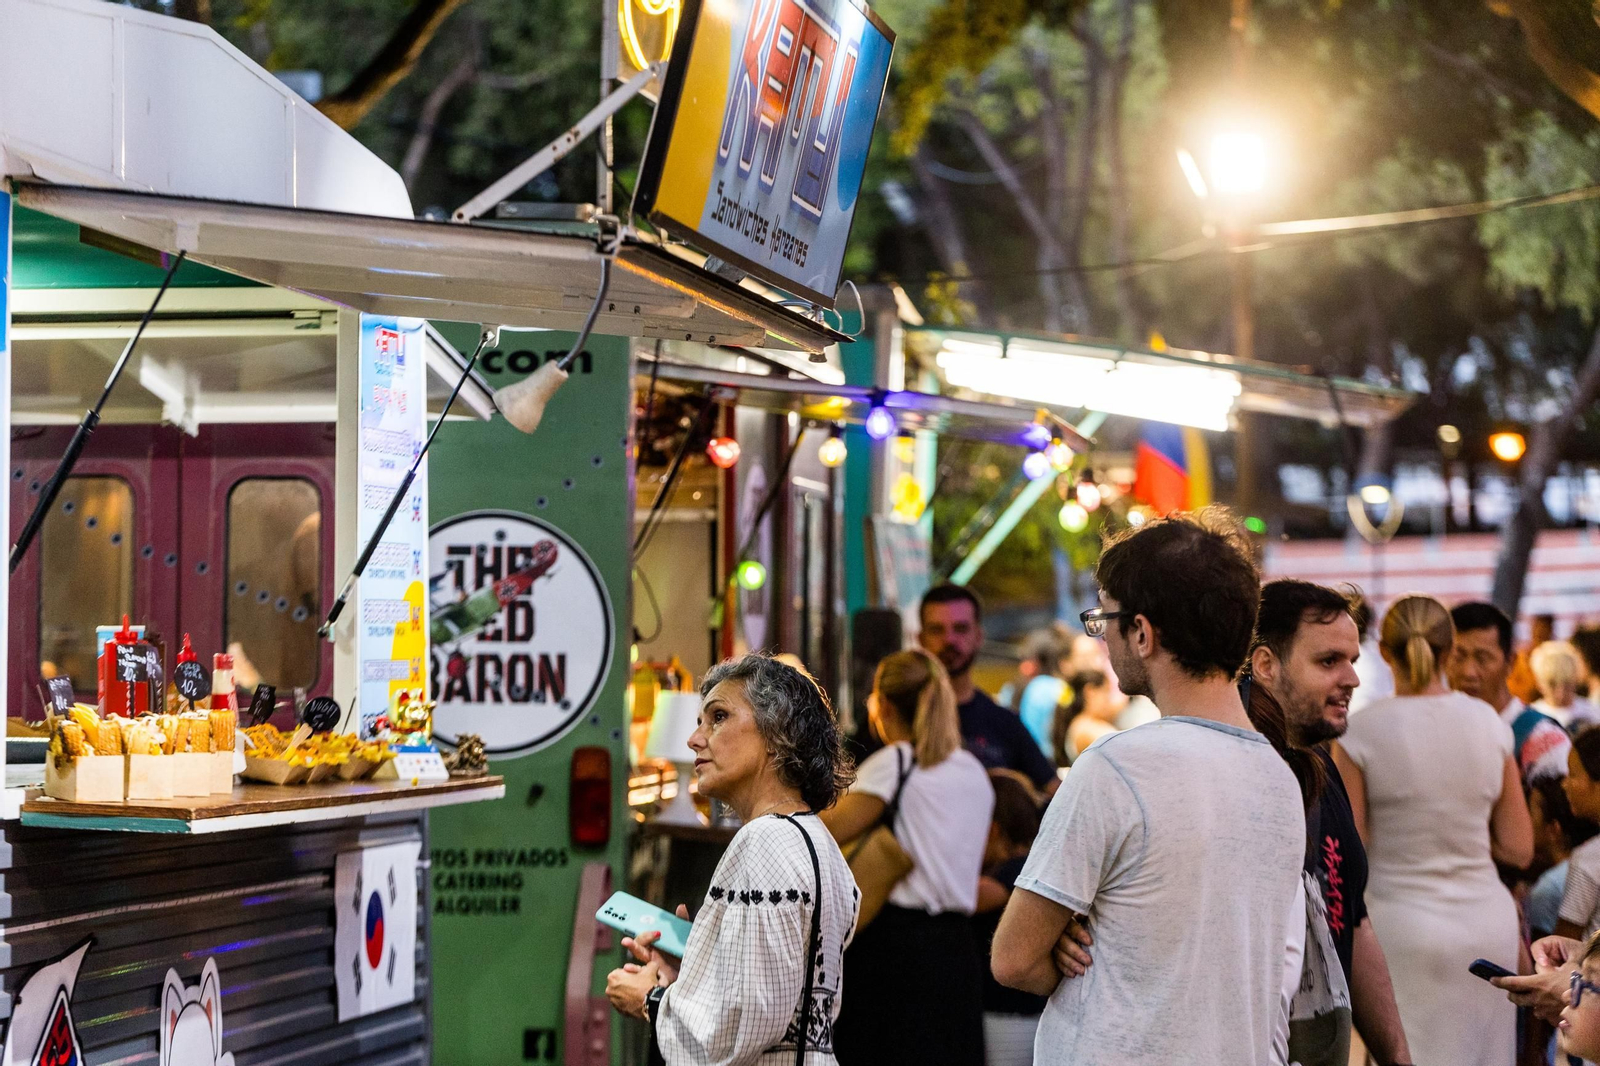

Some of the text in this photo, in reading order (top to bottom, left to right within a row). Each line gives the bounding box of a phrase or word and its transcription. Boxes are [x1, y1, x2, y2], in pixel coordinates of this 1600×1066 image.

[711, 180, 770, 246] Sandwiches
[473, 848, 568, 866] PRIVADOS
[434, 872, 523, 890] CATERING
